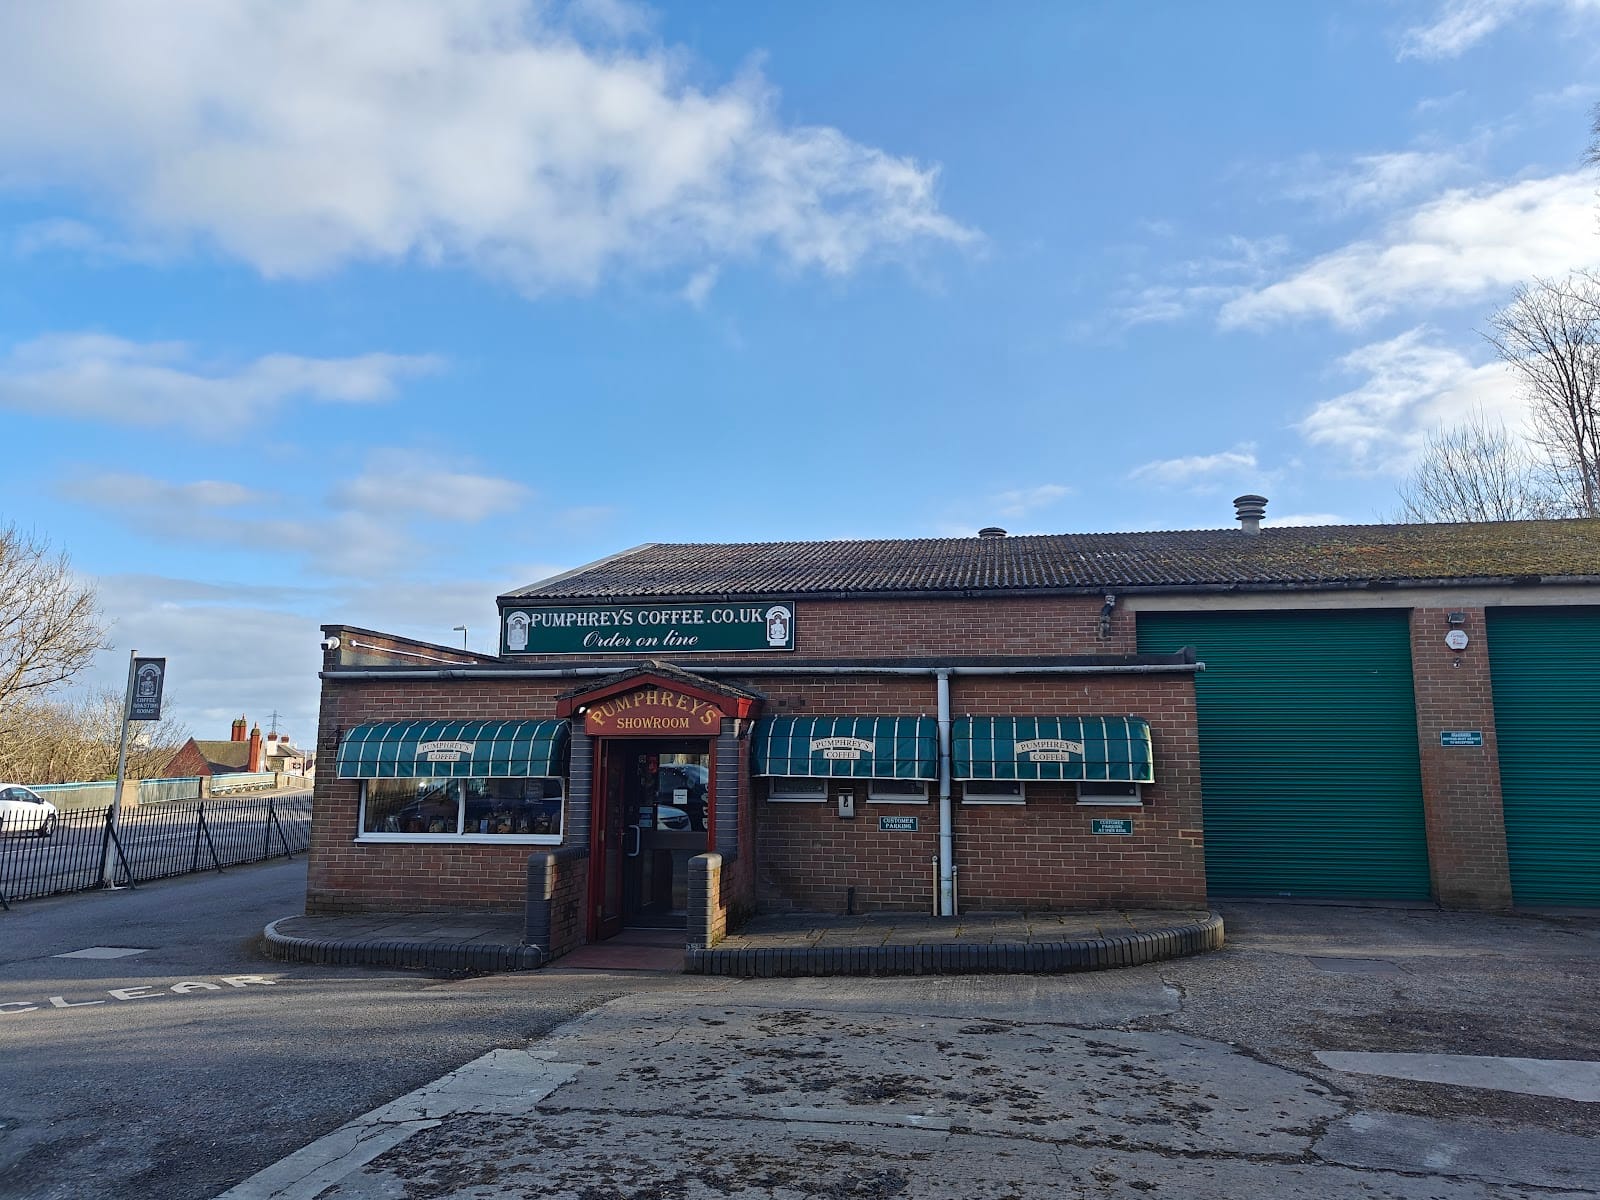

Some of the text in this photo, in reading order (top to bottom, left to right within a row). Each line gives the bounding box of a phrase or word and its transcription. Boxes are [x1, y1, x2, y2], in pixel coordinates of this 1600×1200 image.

[530, 608, 633, 628] PUMPHREY'S
[582, 629, 699, 648] Order on line
[591, 690, 717, 727] PUMPHREY'S
[616, 716, 690, 729] SHOWROOM
[422, 742, 470, 751] PUMPHREY'S
[815, 739, 870, 749] PUMPHREY'S
[1020, 741, 1079, 751] PUMPHREY'S
[826, 751, 858, 759] COFFEE
[1032, 753, 1066, 761] COFFEE
[0, 974, 276, 1015] CLEAR
